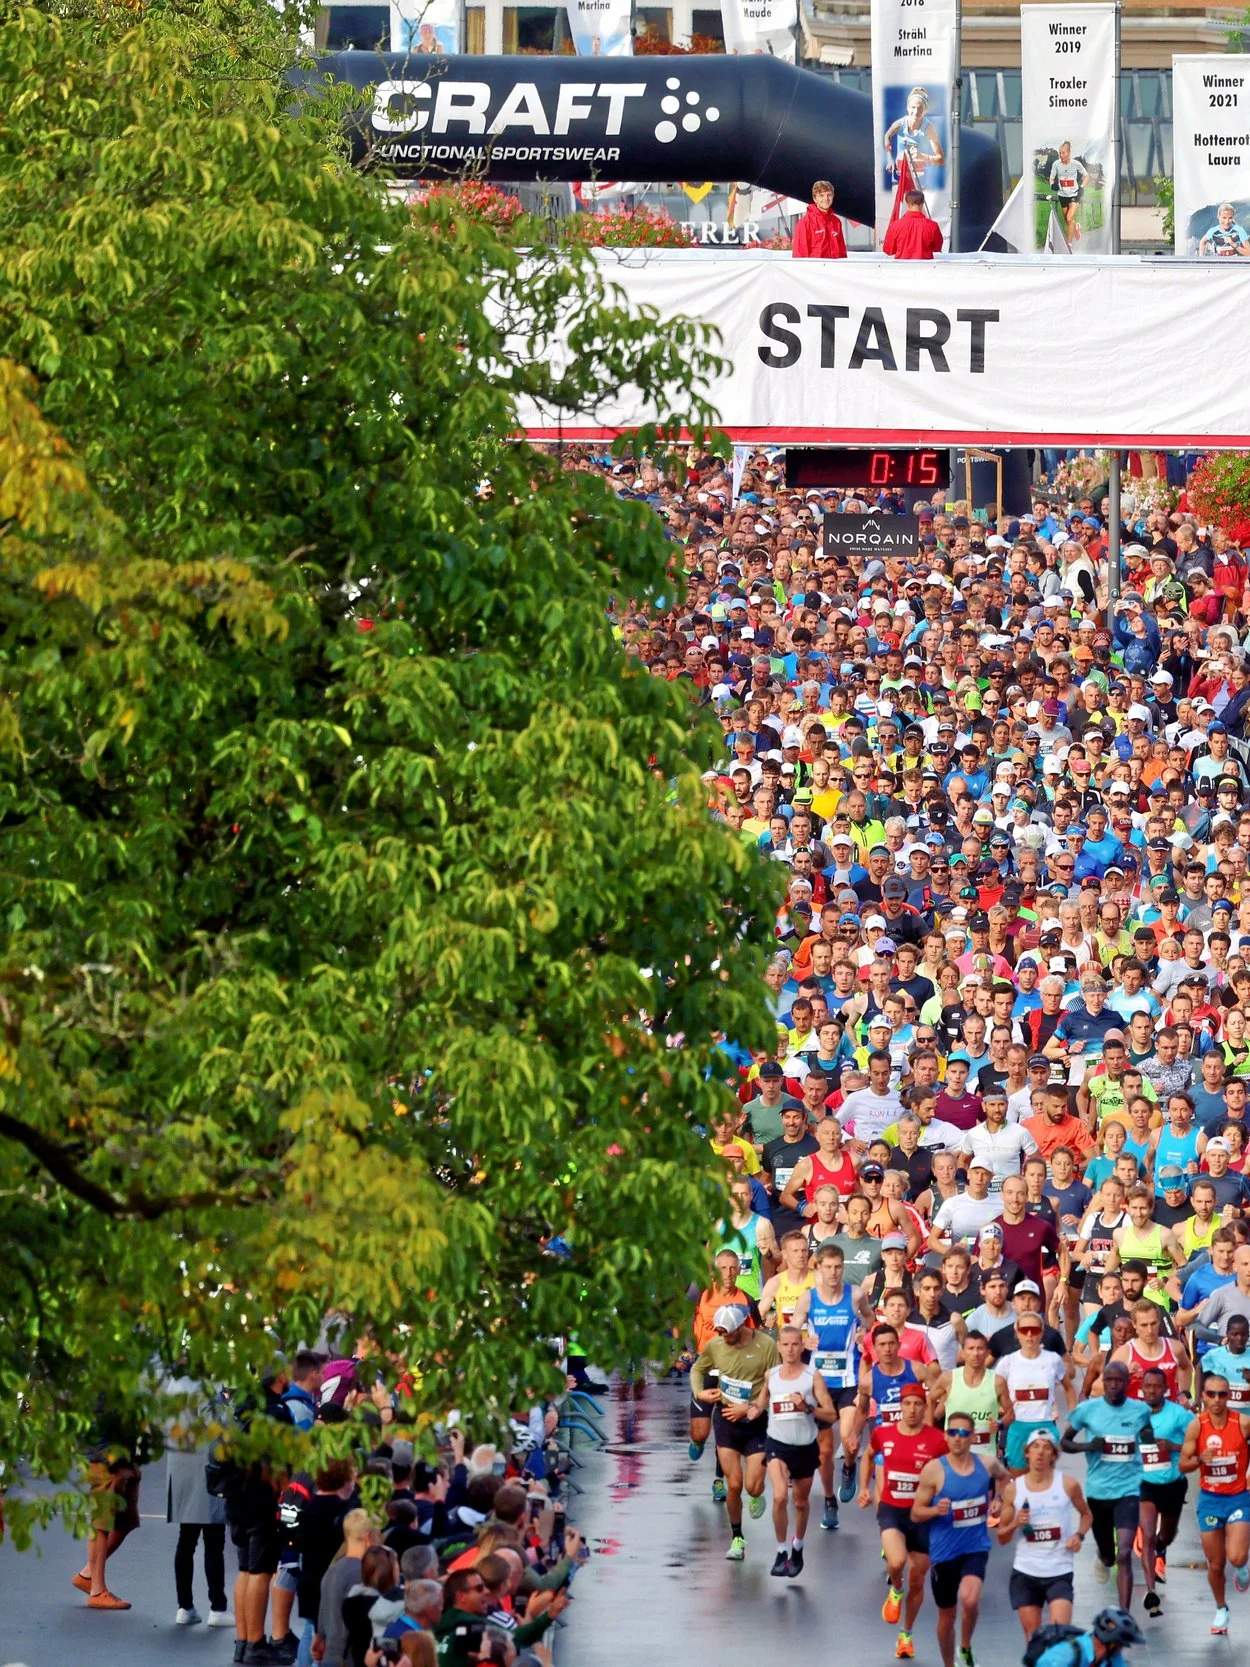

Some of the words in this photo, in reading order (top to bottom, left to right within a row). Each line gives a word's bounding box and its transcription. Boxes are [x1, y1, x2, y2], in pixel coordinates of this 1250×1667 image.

[899, 27, 926, 40] Strähl
[1048, 23, 1087, 36] Winner
[894, 45, 932, 57] Martina
[1055, 41, 1081, 53] 2019
[1049, 77, 1087, 90] Troxler
[1203, 74, 1244, 88] Winner
[371, 80, 647, 135] CRAFT
[1049, 95, 1088, 108] Simone
[1209, 94, 1238, 108] 2021
[490, 146, 620, 161] SPORTSWEAR
[1208, 153, 1241, 166] Laura
[757, 301, 1000, 374] START
[870, 453, 937, 484] 0:15
[828, 533, 914, 546] NORQAIN
[1029, 1390, 1035, 1399] 1
[1231, 1391, 1242, 1400] 10
[1111, 1444, 1128, 1453] 144
[897, 1482, 913, 1491] 122
[963, 1509, 979, 1518] 107
[1034, 1530, 1051, 1540] 106
